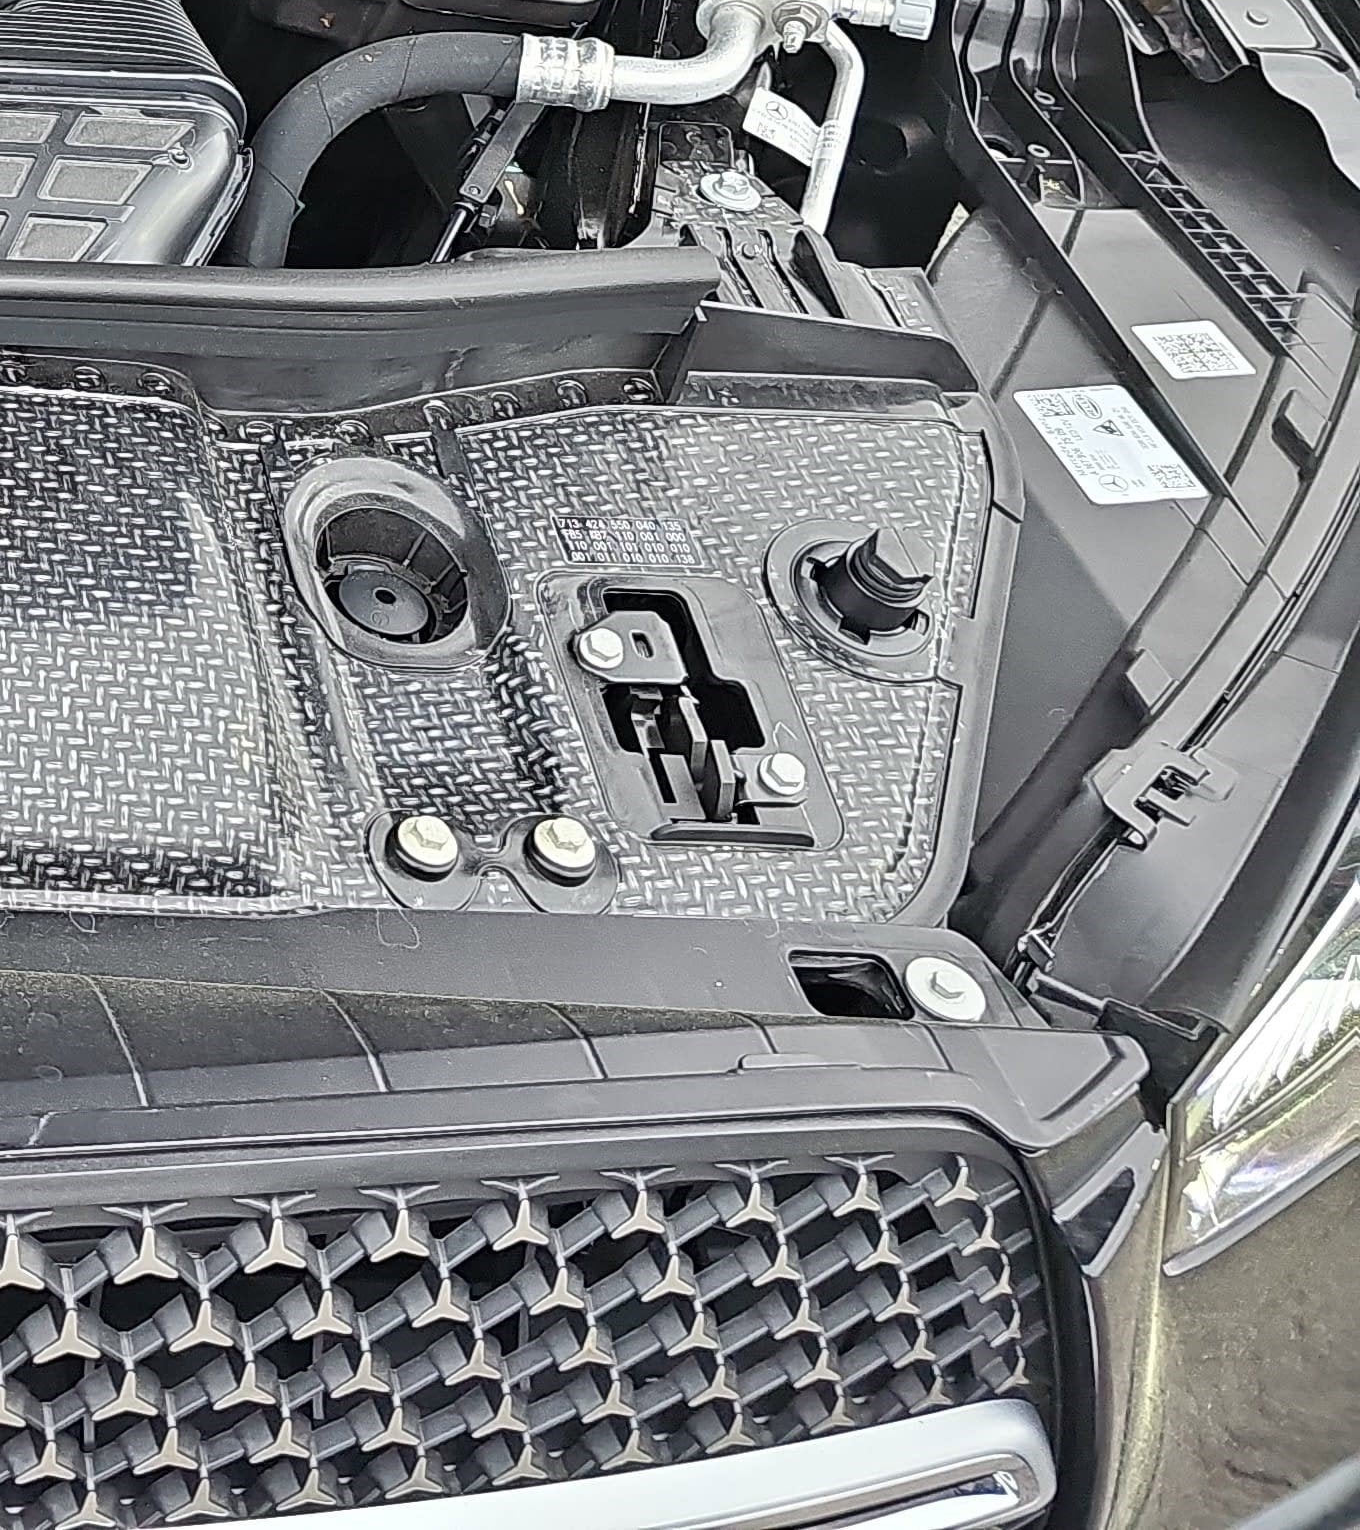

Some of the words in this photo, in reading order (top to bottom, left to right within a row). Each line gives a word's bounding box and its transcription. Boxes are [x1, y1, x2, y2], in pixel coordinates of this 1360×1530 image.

[559, 519, 579, 528] 713
[611, 521, 630, 530] 550
[636, 521, 655, 530] 040
[662, 522, 681, 531] 135
[640, 532, 660, 541] 001
[666, 533, 685, 542] 000
[645, 543, 665, 552] 010
[670, 544, 690, 553] 010
[623, 553, 643, 562] 010
[649, 554, 669, 563] 010
[676, 554, 695, 564] 138
